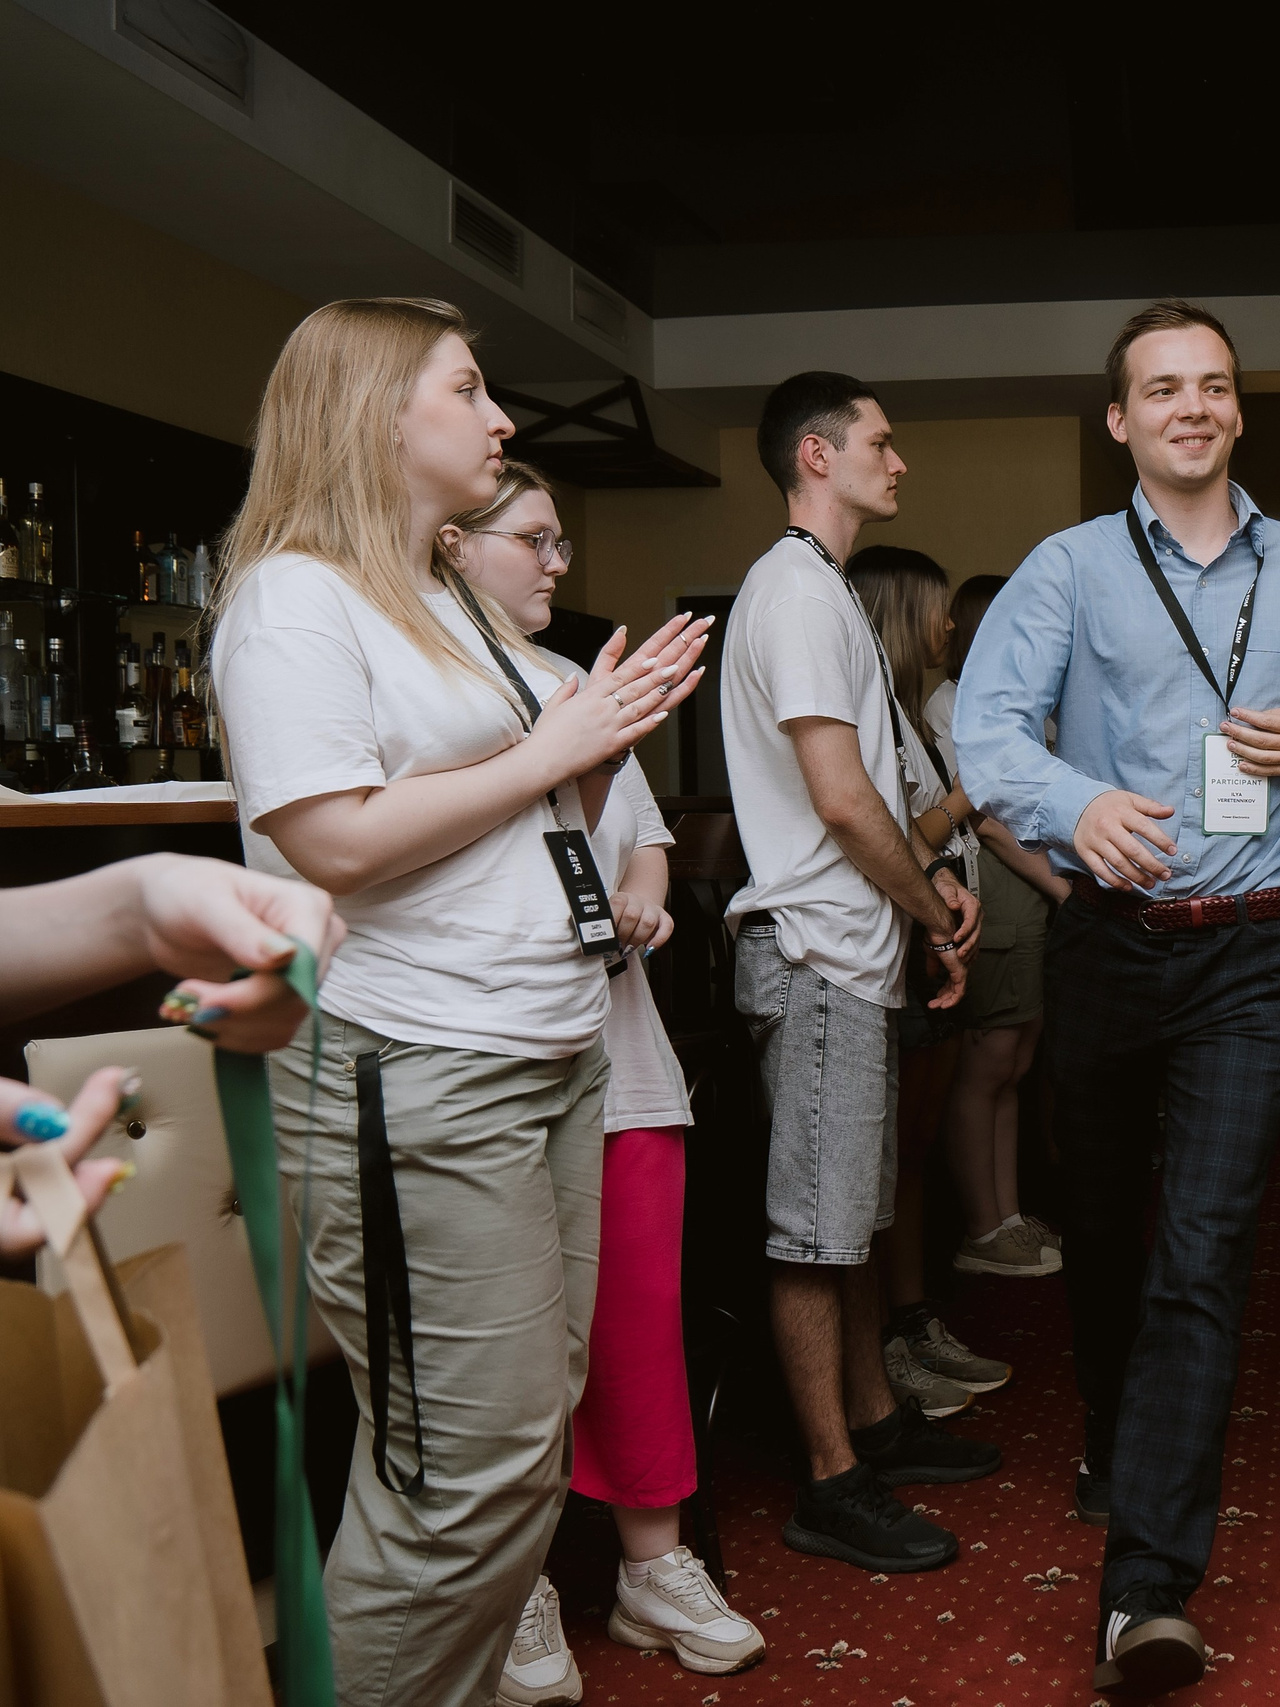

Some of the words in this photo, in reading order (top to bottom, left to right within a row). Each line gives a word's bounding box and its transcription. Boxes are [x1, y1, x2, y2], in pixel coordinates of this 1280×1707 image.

[573, 863, 583, 875] 25
[578, 894, 598, 903] SERVICE
[584, 904, 599, 914] GROUP
